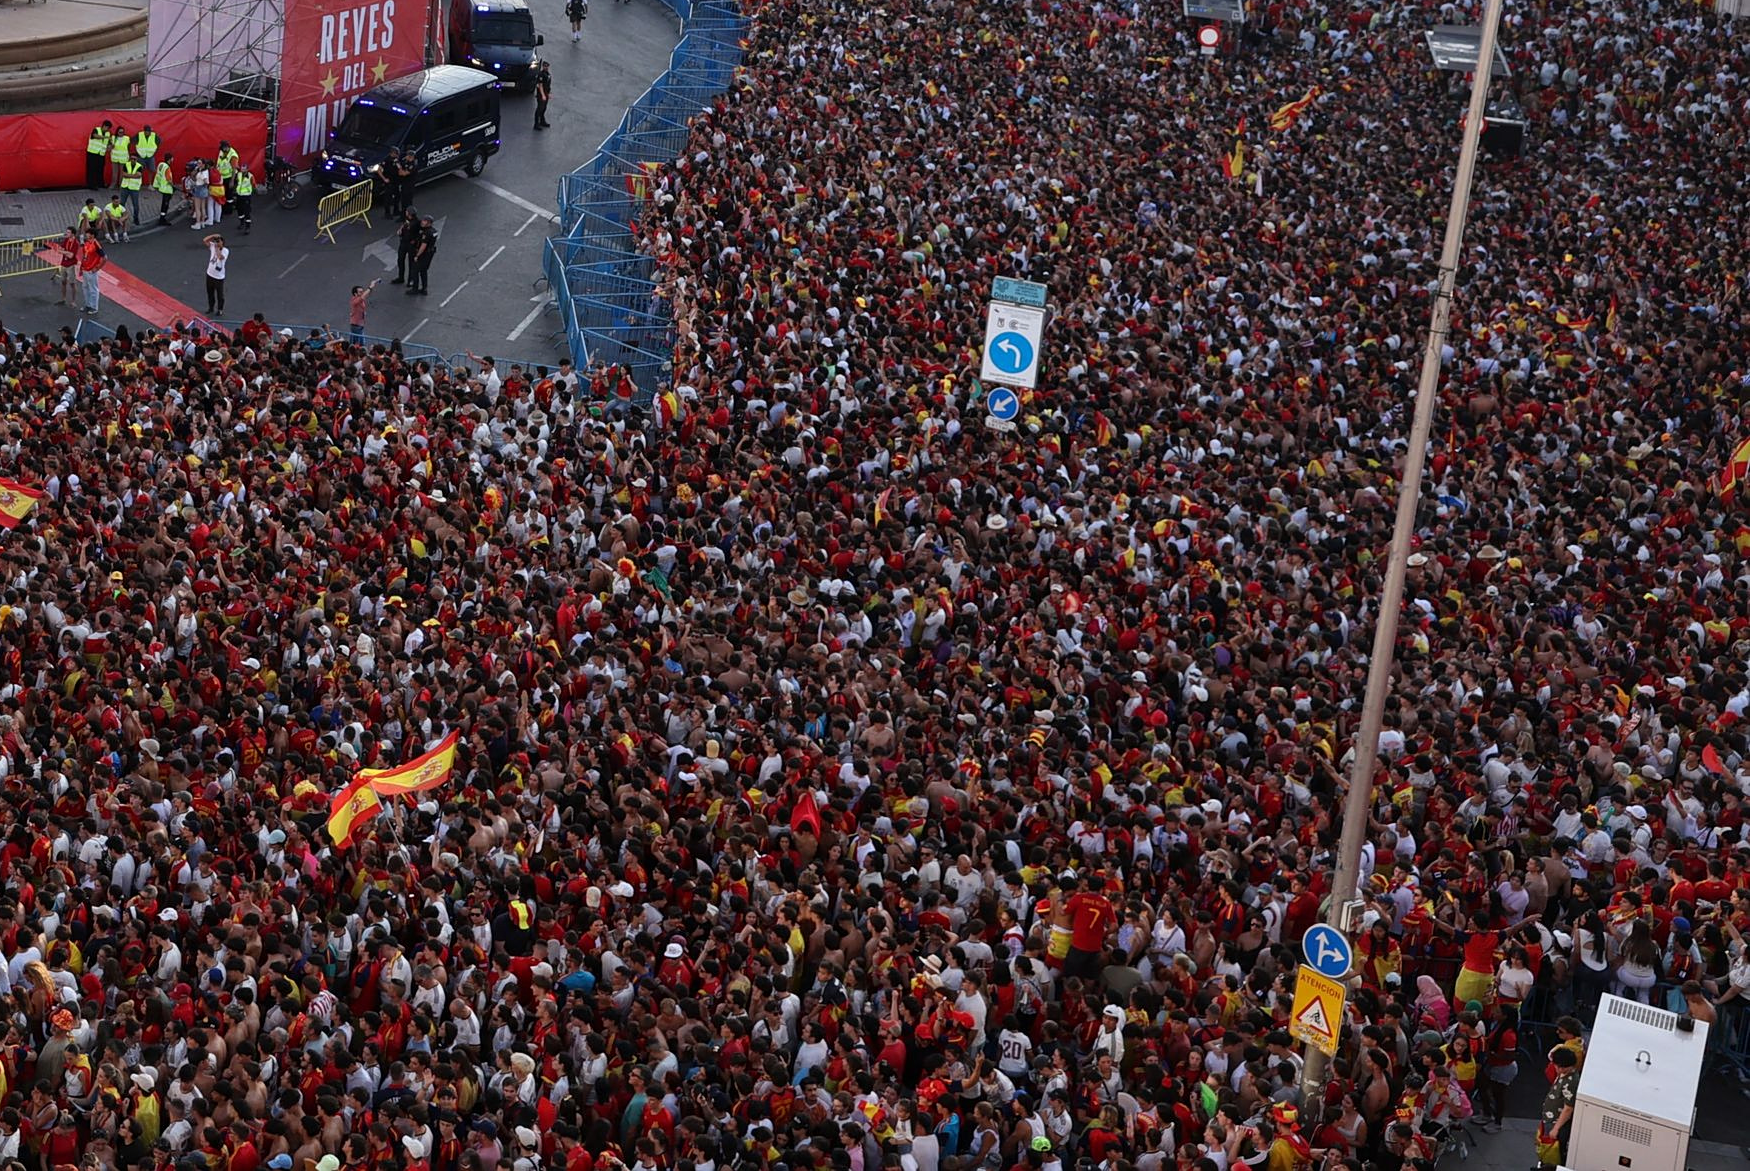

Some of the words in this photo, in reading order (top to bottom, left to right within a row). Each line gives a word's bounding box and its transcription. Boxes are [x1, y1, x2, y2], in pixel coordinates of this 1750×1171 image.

[319, 0, 396, 65] REYES
[342, 61, 366, 92] DEL
[993, 292, 1019, 302] Distrito
[1019, 296, 1043, 306] Centro
[1088, 907, 1101, 929] 7
[1300, 974, 1341, 1000] ATENCION
[1003, 1039, 1022, 1061] 20
